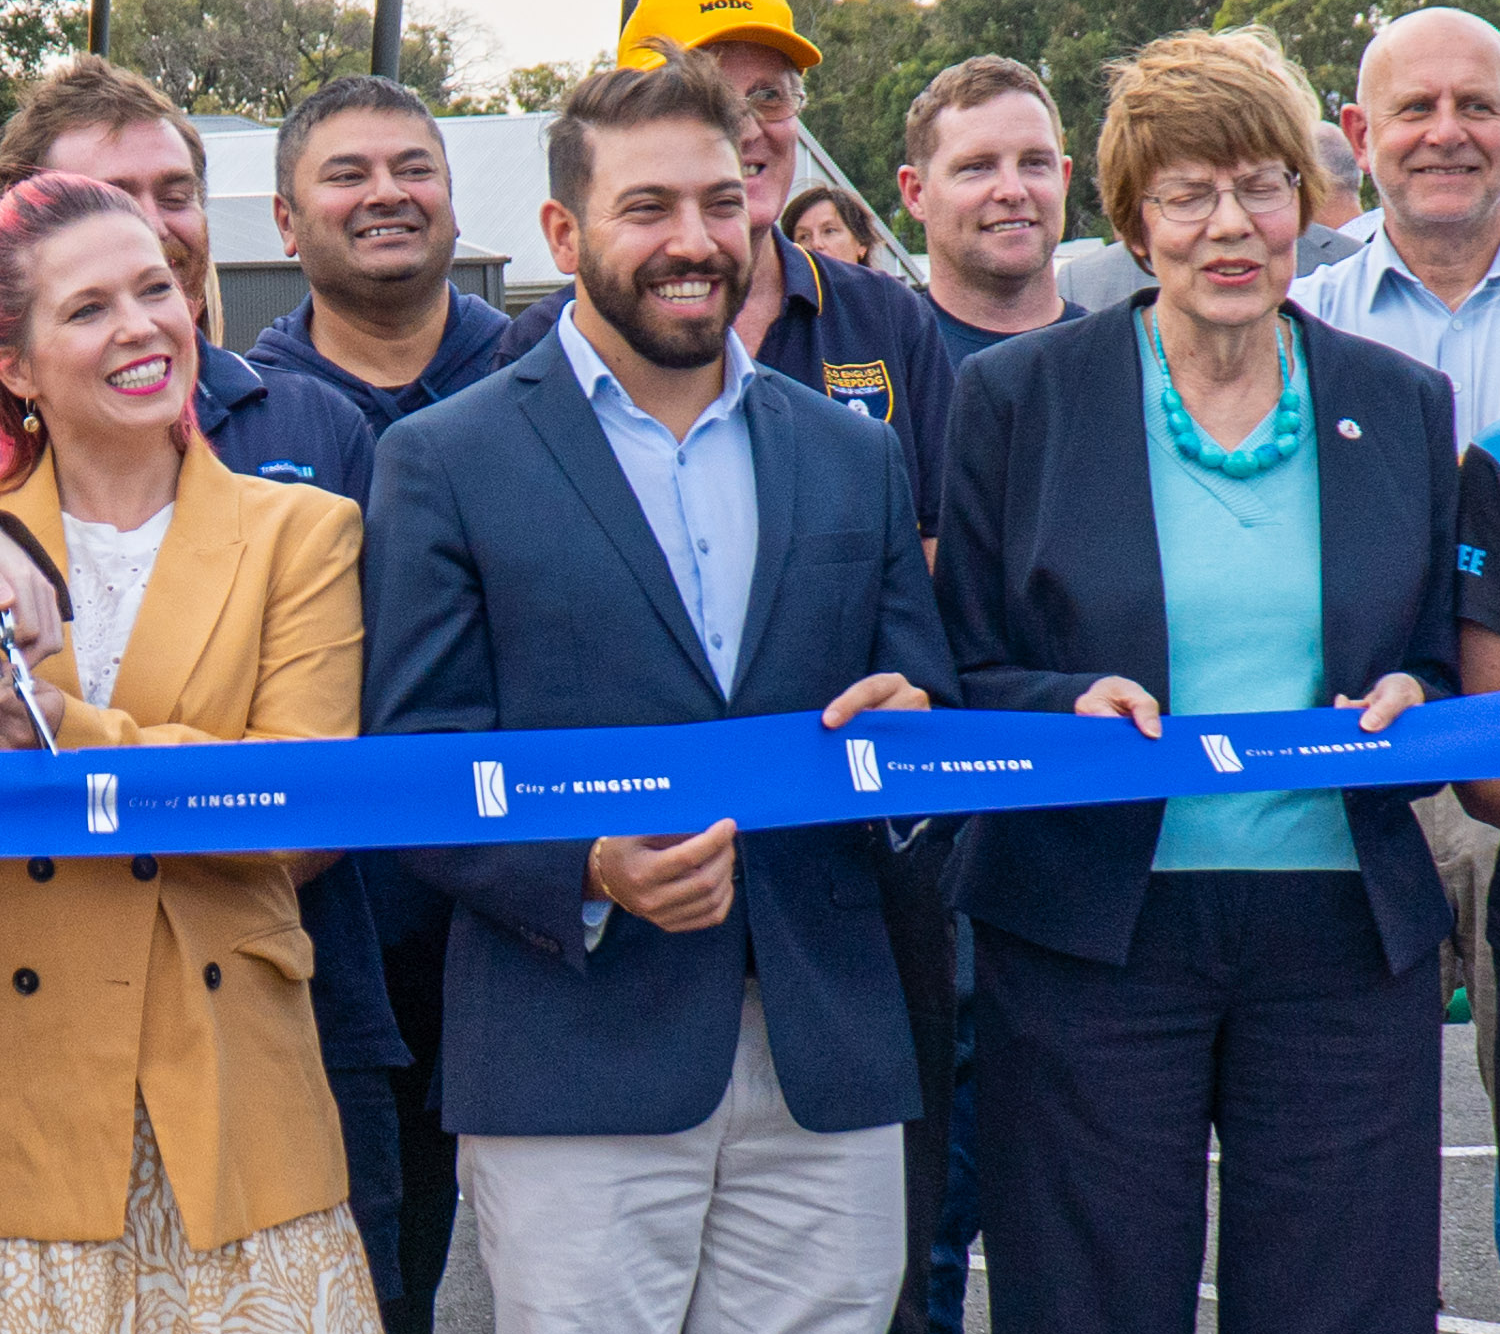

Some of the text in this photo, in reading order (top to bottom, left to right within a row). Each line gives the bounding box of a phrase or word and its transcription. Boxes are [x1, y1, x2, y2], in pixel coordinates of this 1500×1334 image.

[1299, 740, 1392, 755] KINGSTON
[887, 759, 1034, 772] City of KINGSTON
[515, 777, 671, 795] City of KINGSTON
[128, 792, 286, 809] City of KINGSTON
